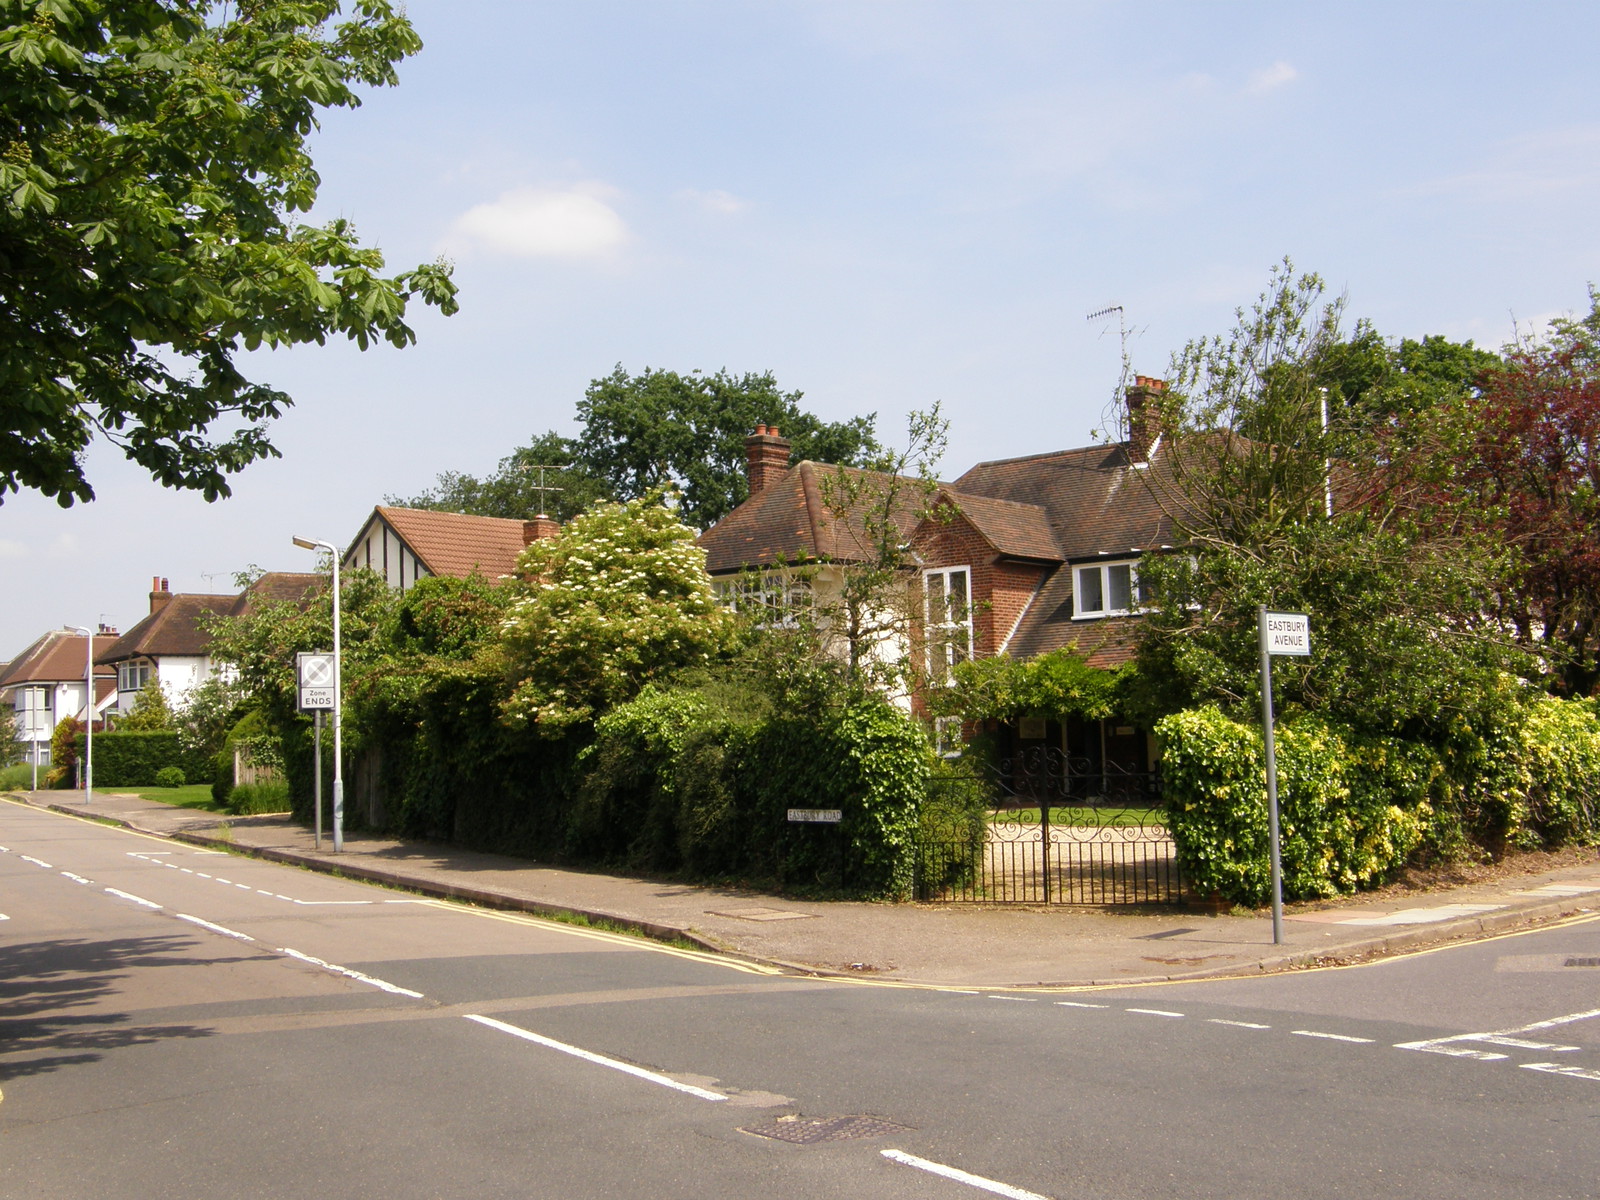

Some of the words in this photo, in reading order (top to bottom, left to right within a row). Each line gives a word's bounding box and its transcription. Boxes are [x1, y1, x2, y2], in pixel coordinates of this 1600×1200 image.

[1268, 620, 1306, 632] EASTBURY
[1274, 634, 1303, 646] AVENUE
[305, 697, 331, 705] ENDS
[788, 810, 820, 820] EASTBURY
